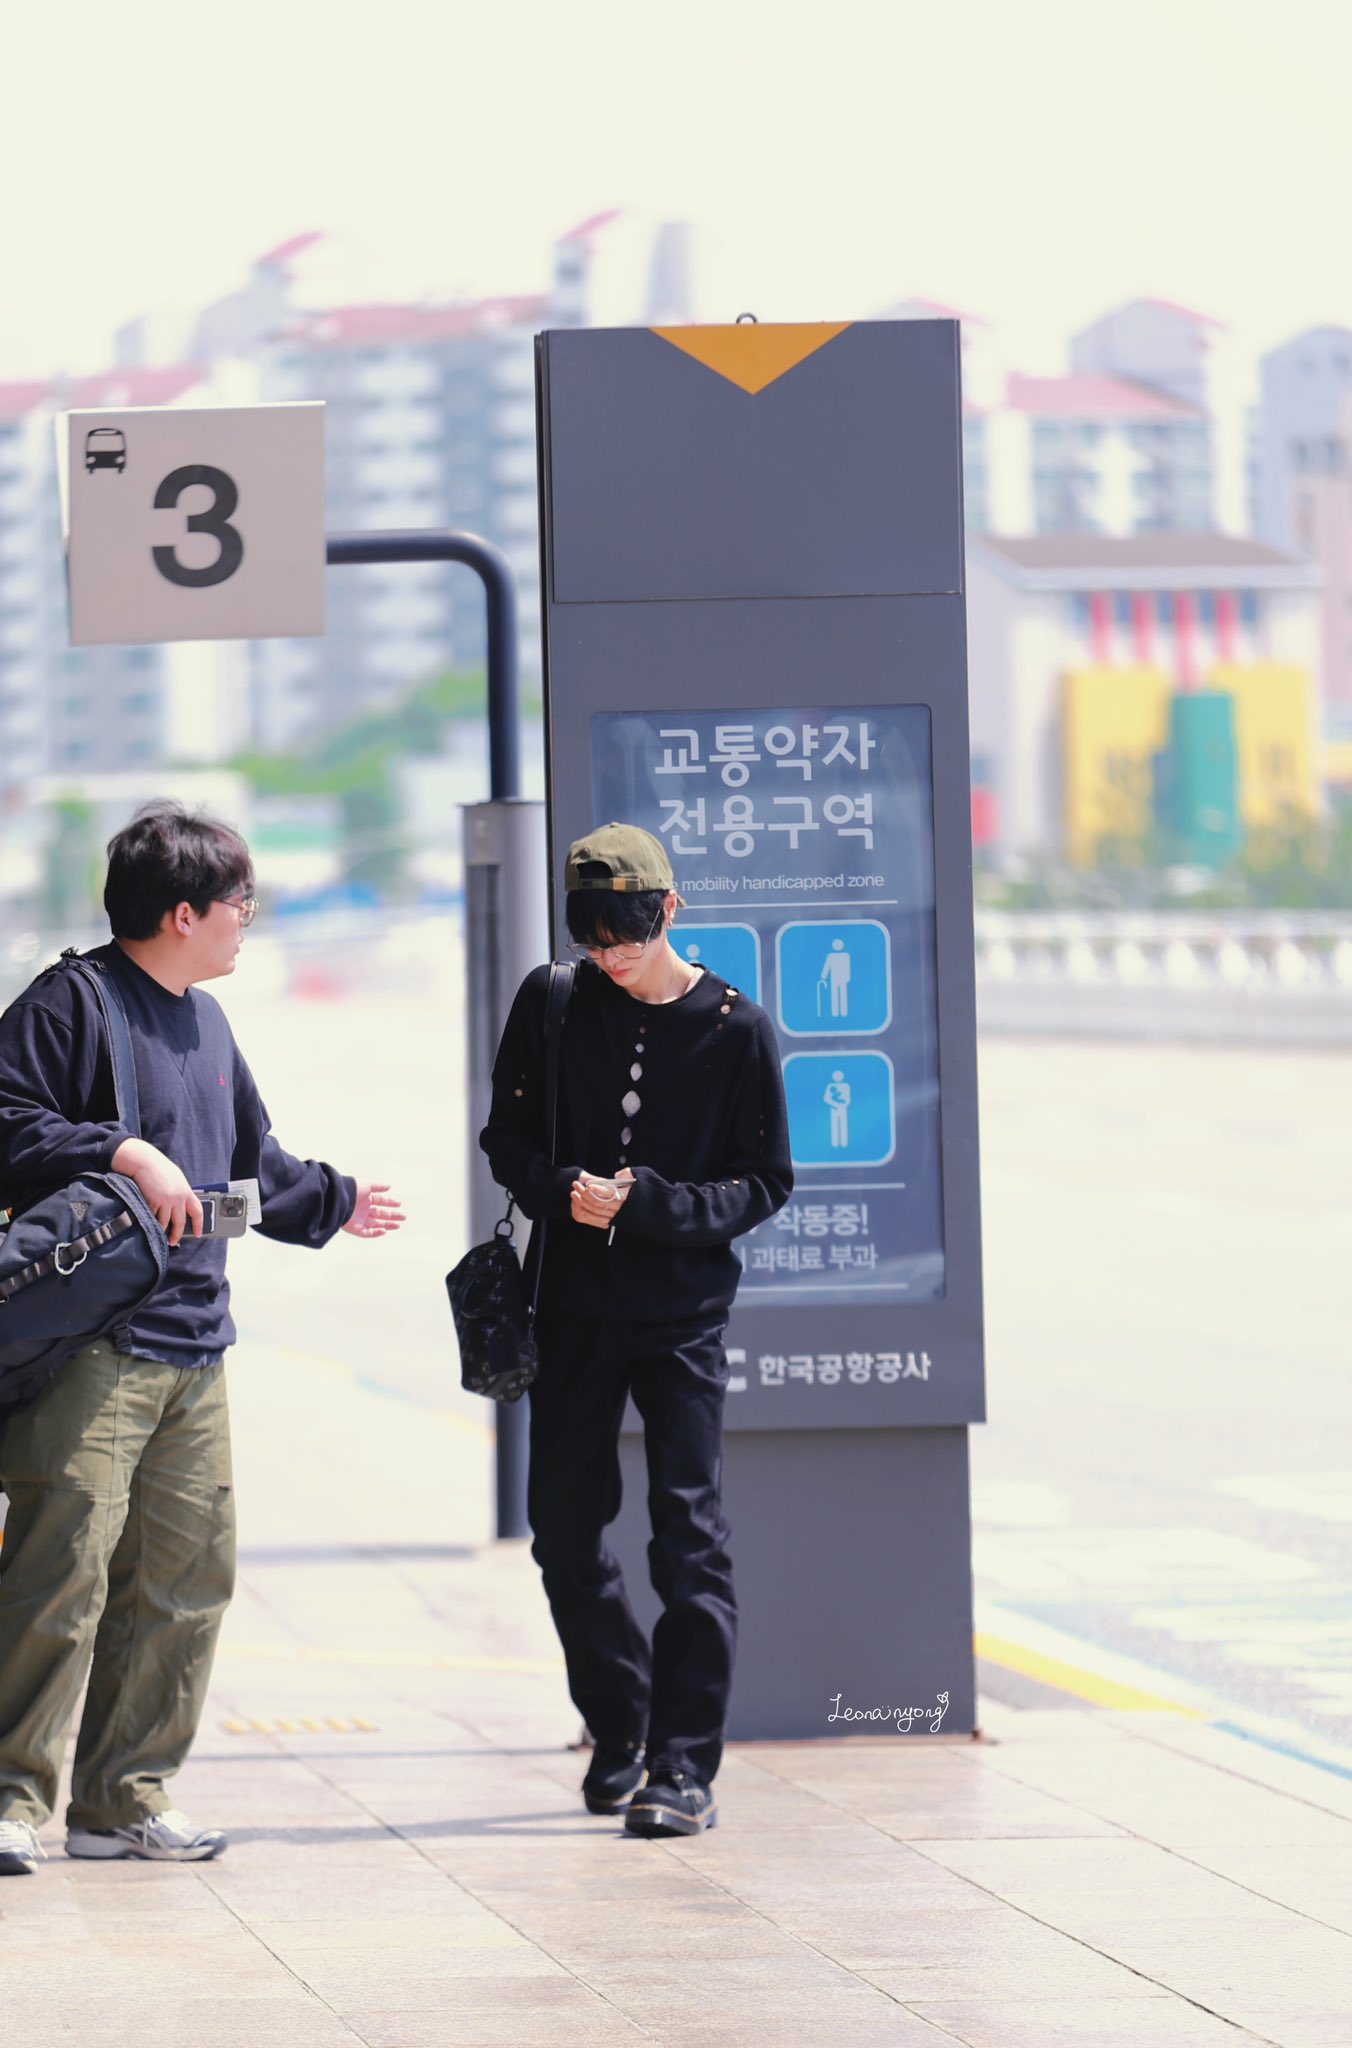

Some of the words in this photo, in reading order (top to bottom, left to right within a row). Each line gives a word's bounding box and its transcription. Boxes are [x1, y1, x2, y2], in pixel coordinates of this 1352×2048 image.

[152, 464, 243, 588] 3
[655, 723, 876, 788] 교통약자
[659, 793, 874, 858] 전용구역
[682, 876, 739, 893] mobility
[742, 874, 844, 892] handicapped
[847, 874, 885, 887] zone
[773, 1203, 869, 1237] 작동중!
[752, 1246, 825, 1273] 과태료
[829, 1243, 878, 1271] 부과
[758, 1351, 932, 1386] 한국공항공사
